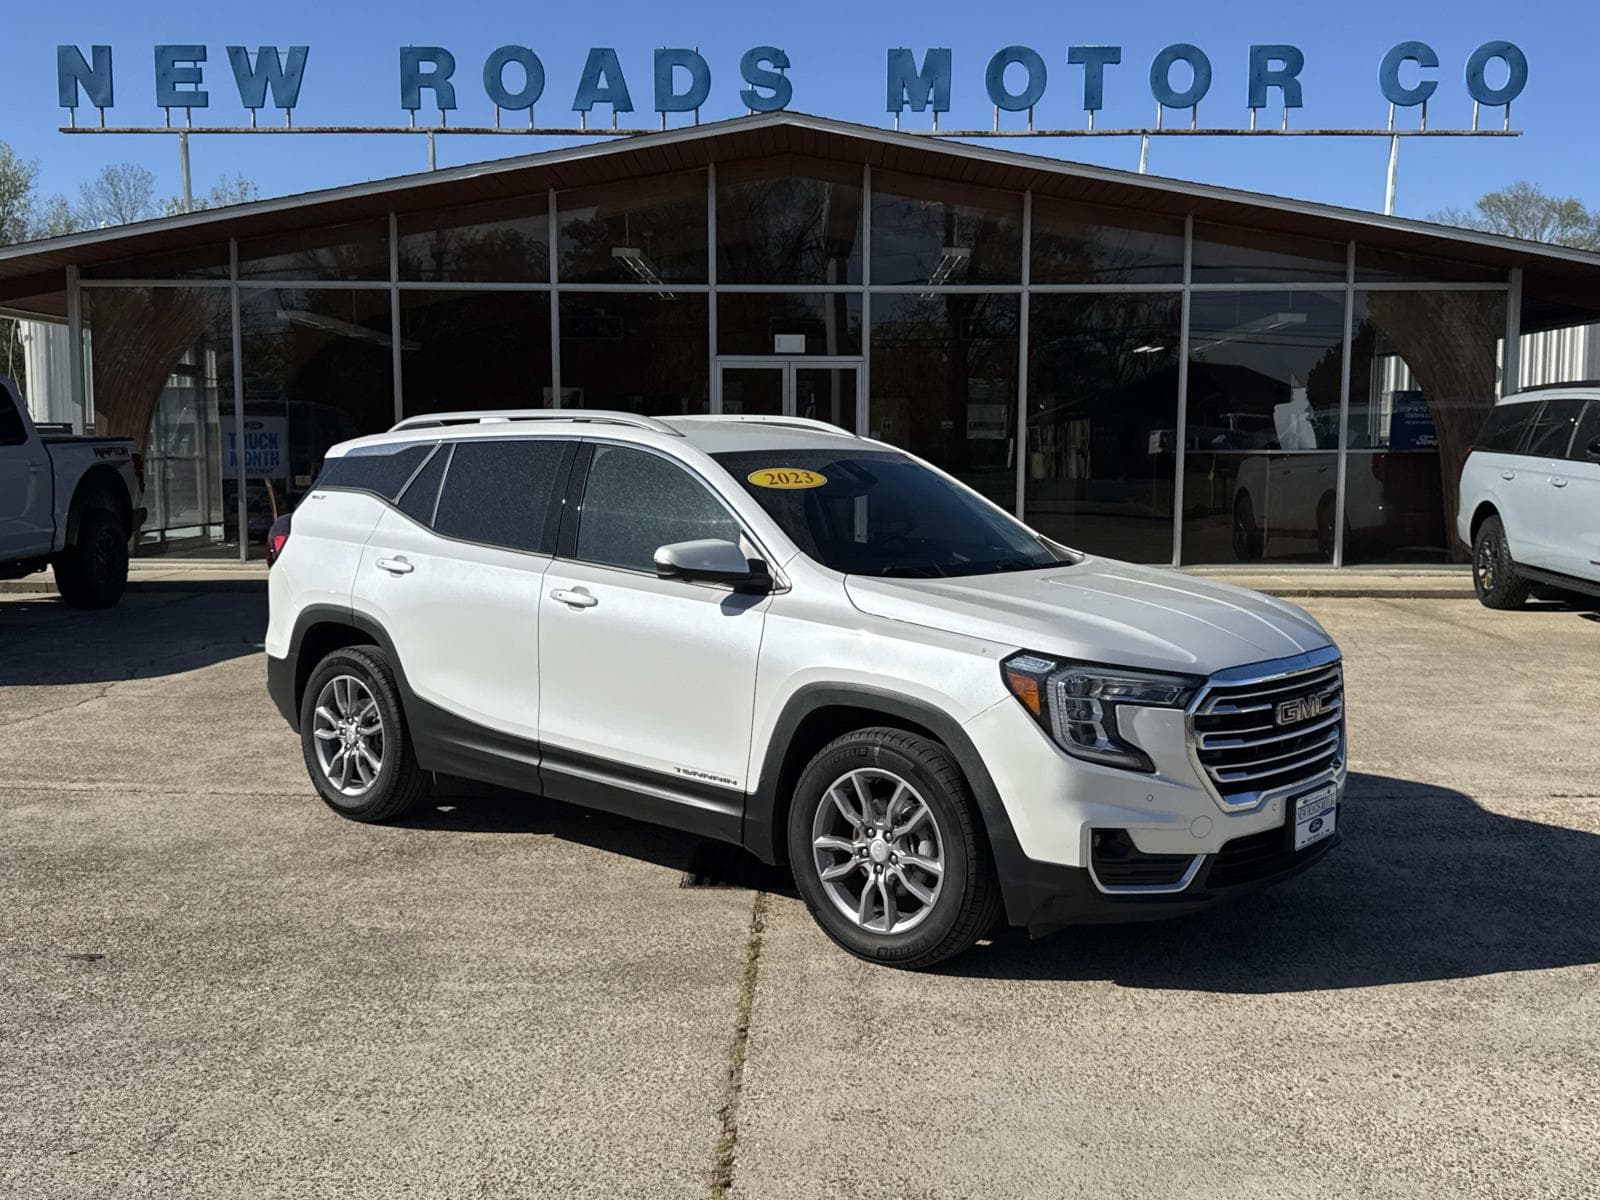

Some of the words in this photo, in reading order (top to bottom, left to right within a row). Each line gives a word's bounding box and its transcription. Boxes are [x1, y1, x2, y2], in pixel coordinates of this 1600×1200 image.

[57, 44, 309, 108] NEW
[400, 45, 793, 112] ROADS
[886, 43, 1303, 112] MOTOR
[1378, 40, 1528, 107] CO
[228, 431, 279, 450] TUCK
[765, 471, 814, 486] 2023
[1277, 693, 1332, 725] GMC
